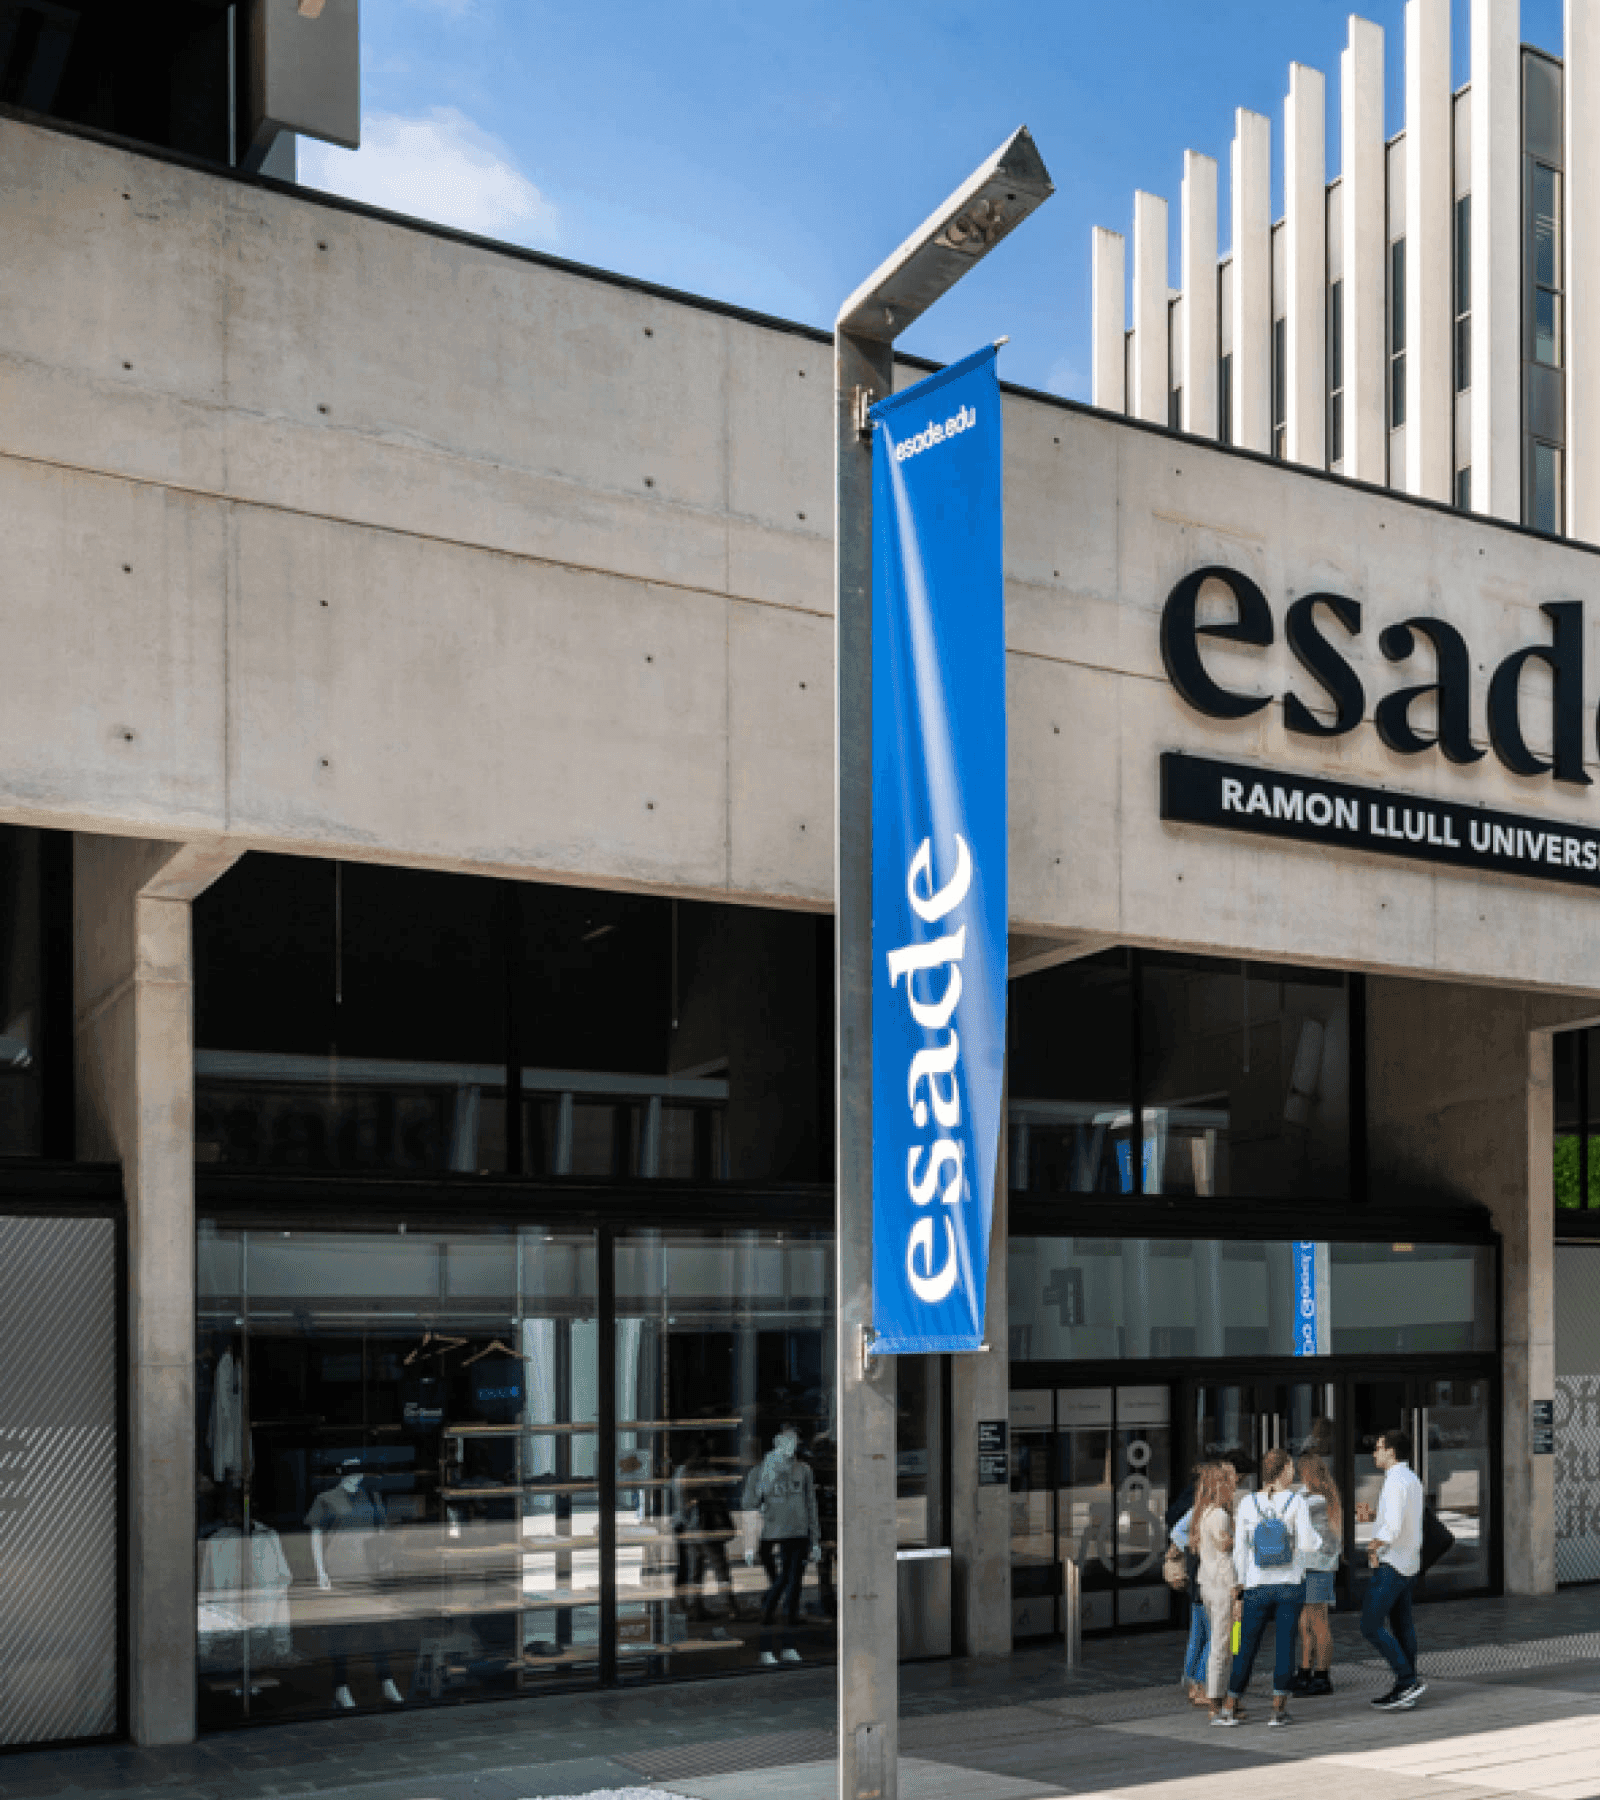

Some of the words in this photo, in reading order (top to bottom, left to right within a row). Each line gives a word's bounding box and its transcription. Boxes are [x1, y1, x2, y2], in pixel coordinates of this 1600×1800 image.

[895, 404, 976, 462] esade.edu
[1221, 776, 1359, 831] RAMON
[1369, 803, 1461, 848] LLULL
[886, 832, 971, 1303] esade
